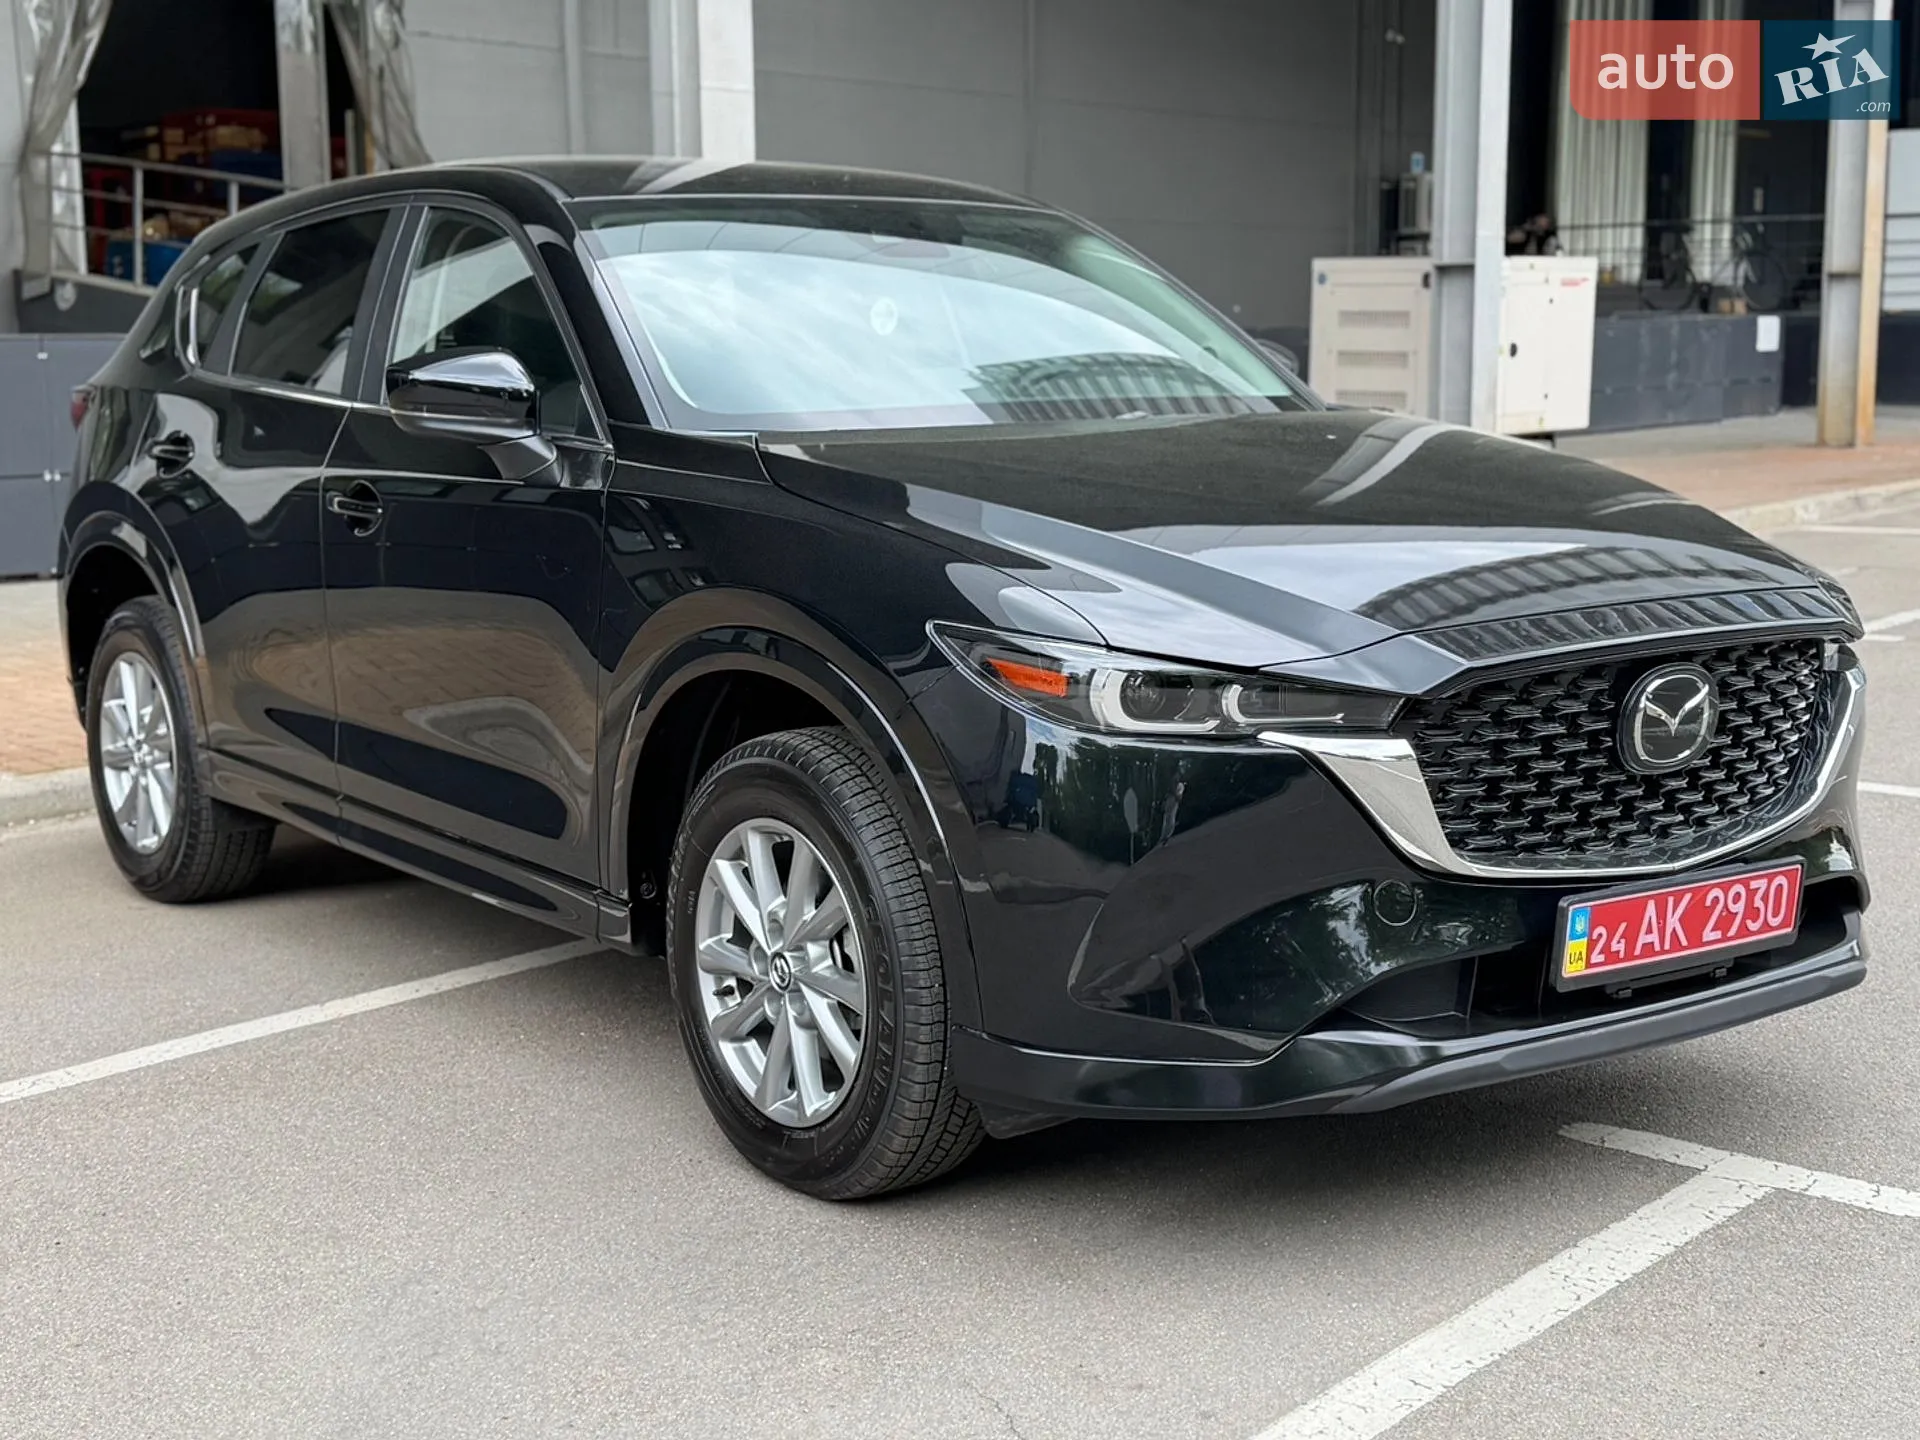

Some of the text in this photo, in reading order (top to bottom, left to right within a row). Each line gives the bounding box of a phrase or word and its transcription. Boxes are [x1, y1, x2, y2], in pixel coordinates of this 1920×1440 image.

[1590, 875, 1789, 964] 24 AK 2930
[1569, 950, 1584, 965] UA
